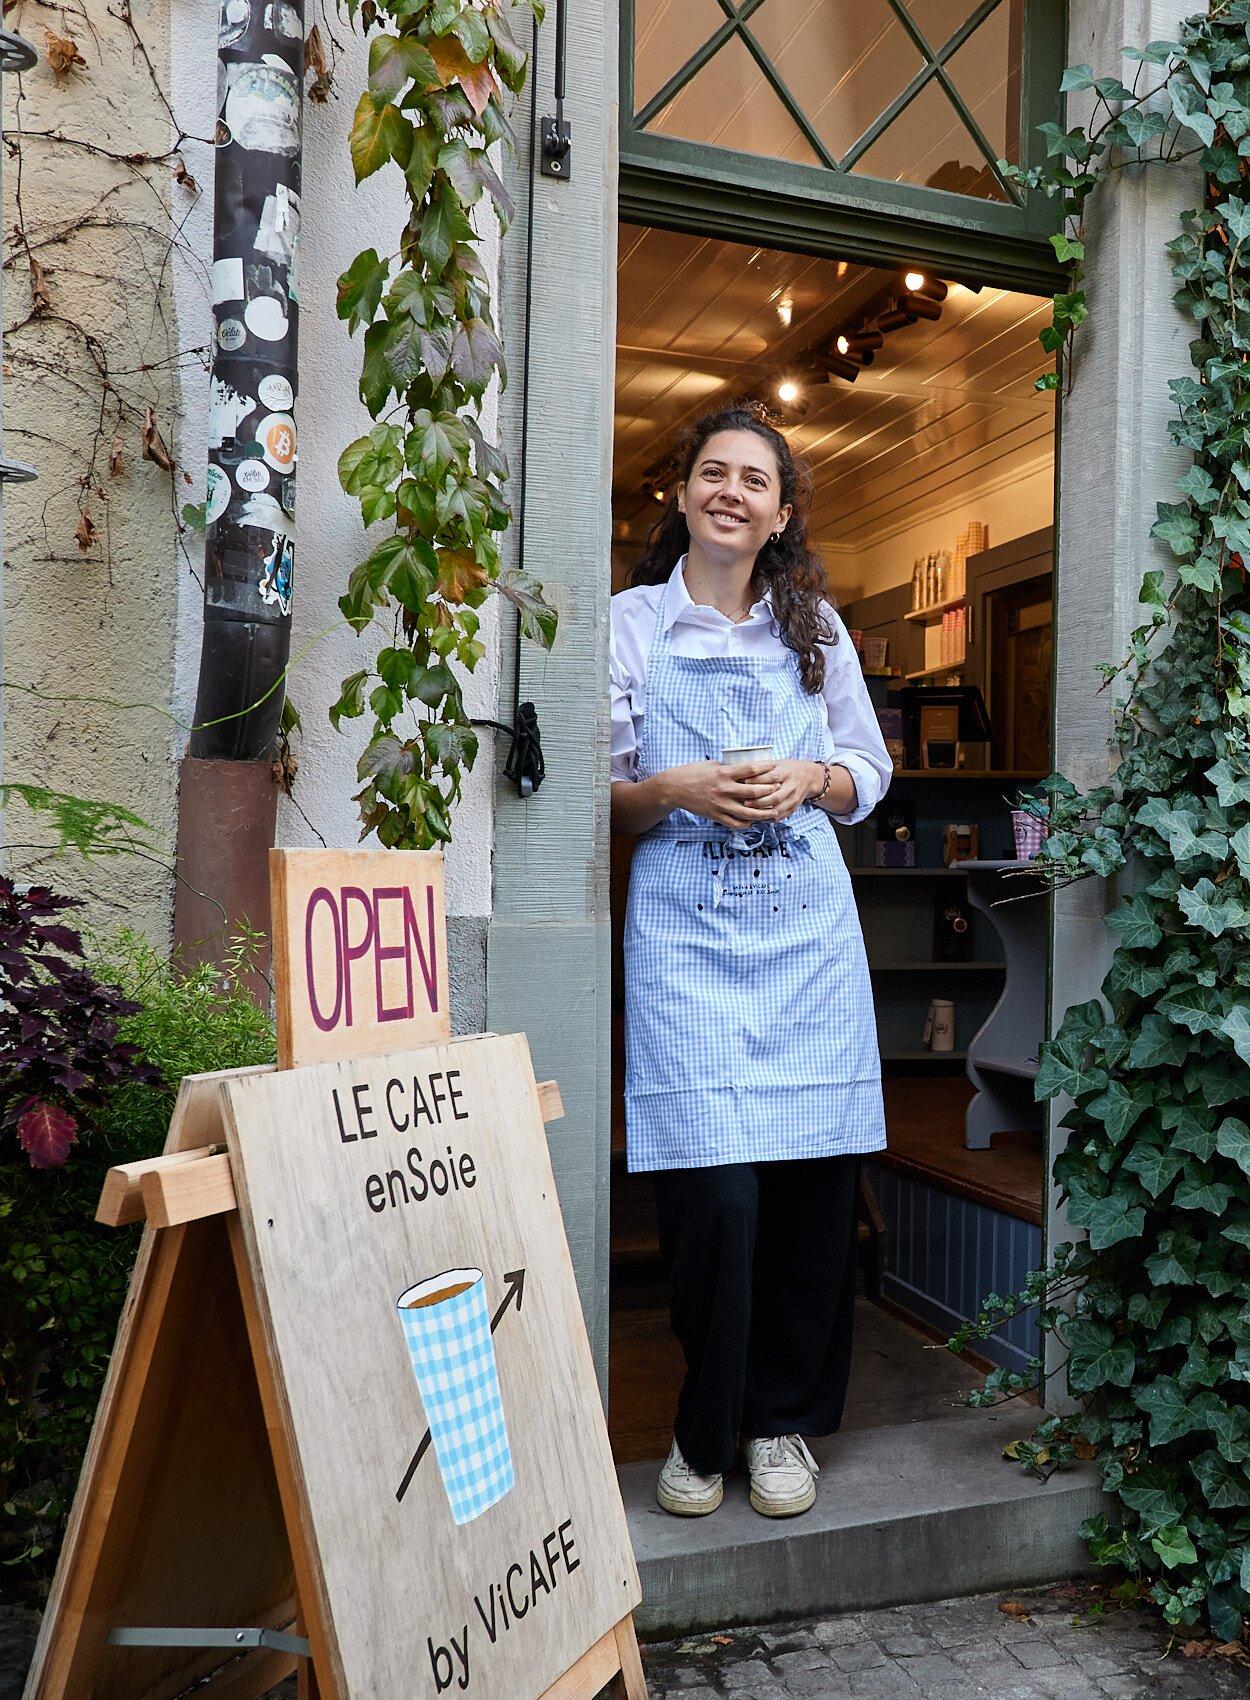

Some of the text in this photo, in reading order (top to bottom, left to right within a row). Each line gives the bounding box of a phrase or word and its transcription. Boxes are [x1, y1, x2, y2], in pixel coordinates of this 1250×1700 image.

[305, 886, 438, 1032] OPEN
[332, 1070, 469, 1143] LE CAFE
[365, 1145, 477, 1213] enSoie
[427, 1518, 581, 1695] by ViCAFE
